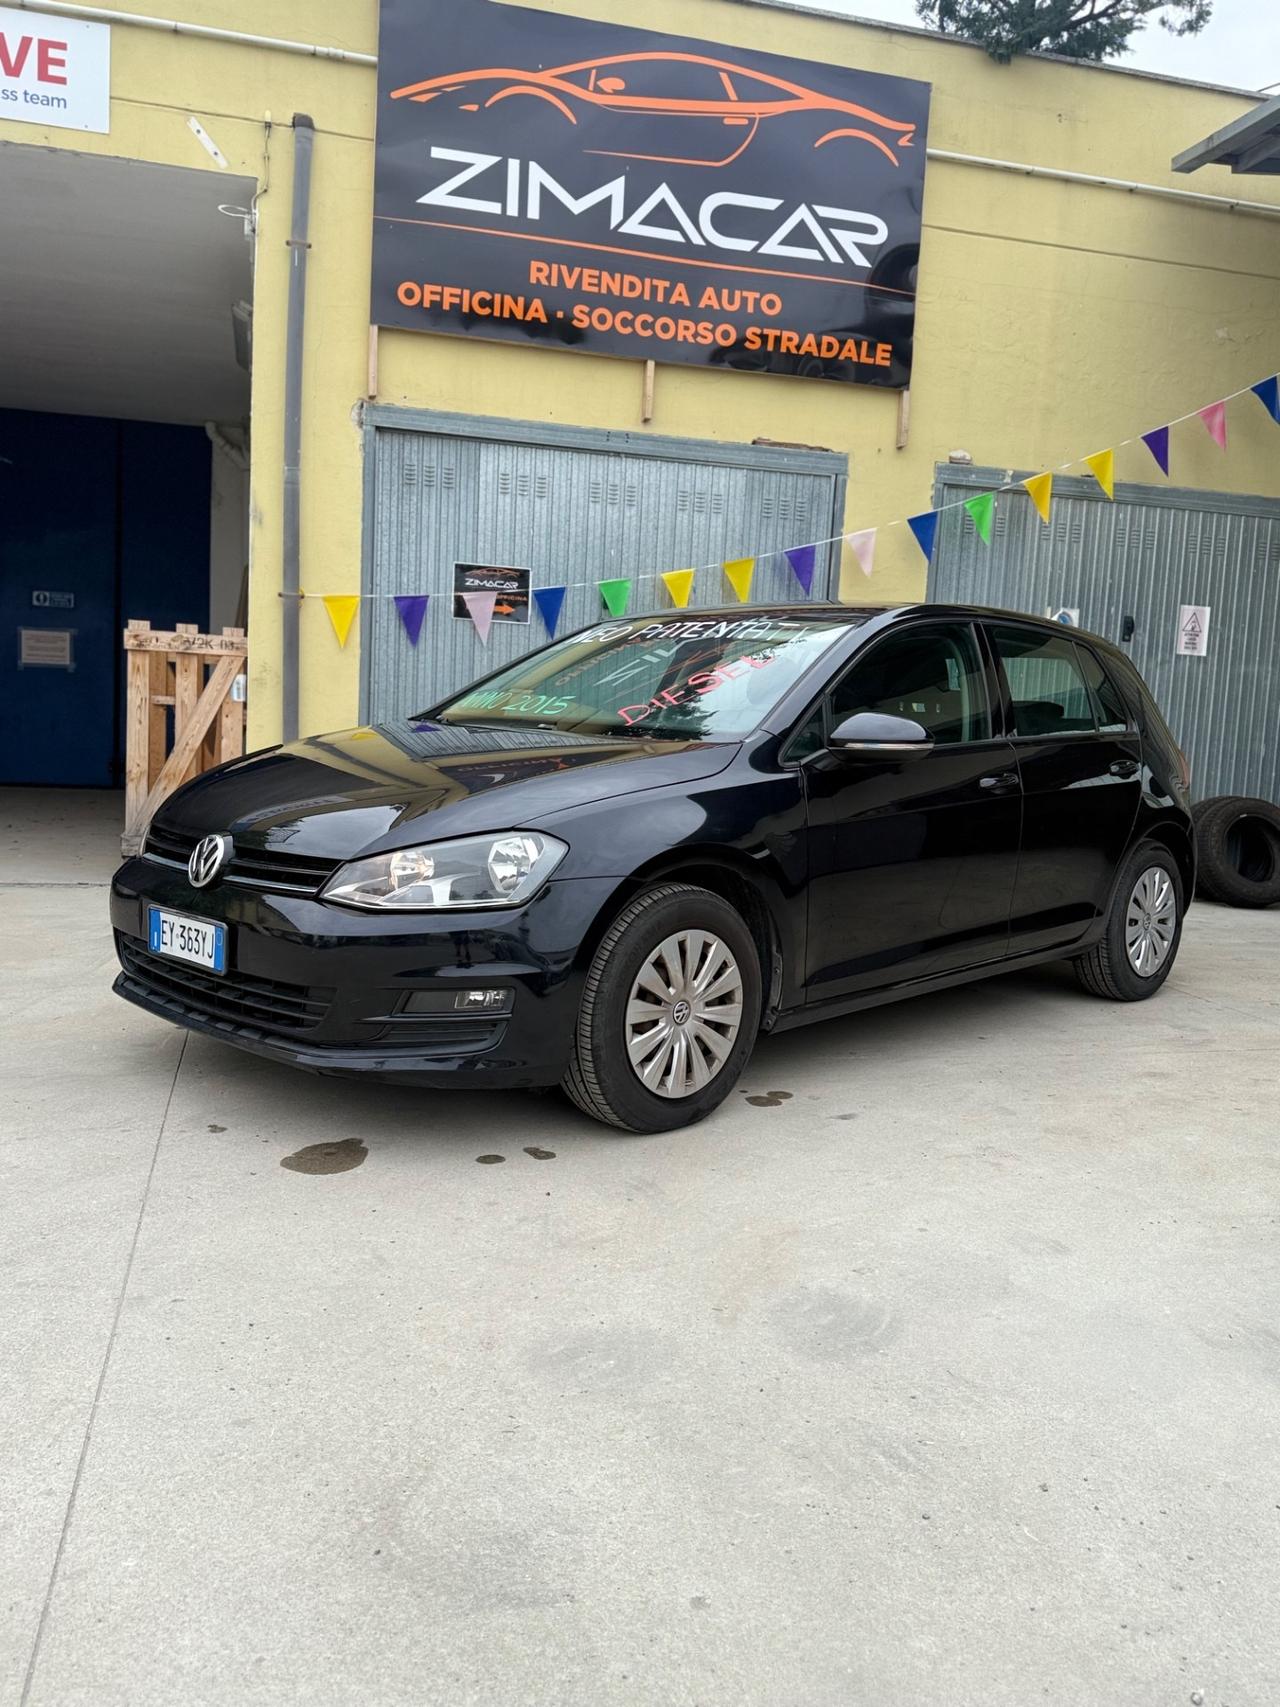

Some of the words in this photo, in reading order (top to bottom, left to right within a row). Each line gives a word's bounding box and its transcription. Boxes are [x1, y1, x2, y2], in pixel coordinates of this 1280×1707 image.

[23, 90, 67, 109] team
[416, 147, 888, 267] ZIMACAR
[529, 260, 691, 307] RIVENDITA
[698, 287, 782, 316] AUTO
[397, 281, 548, 323] OFFICINA
[572, 304, 737, 347] SOCCORSO
[745, 327, 893, 366] STRADALE
[465, 578, 519, 589] ZIMACAR
[502, 696, 576, 714] 2015
[618, 654, 777, 726] DIESEL
